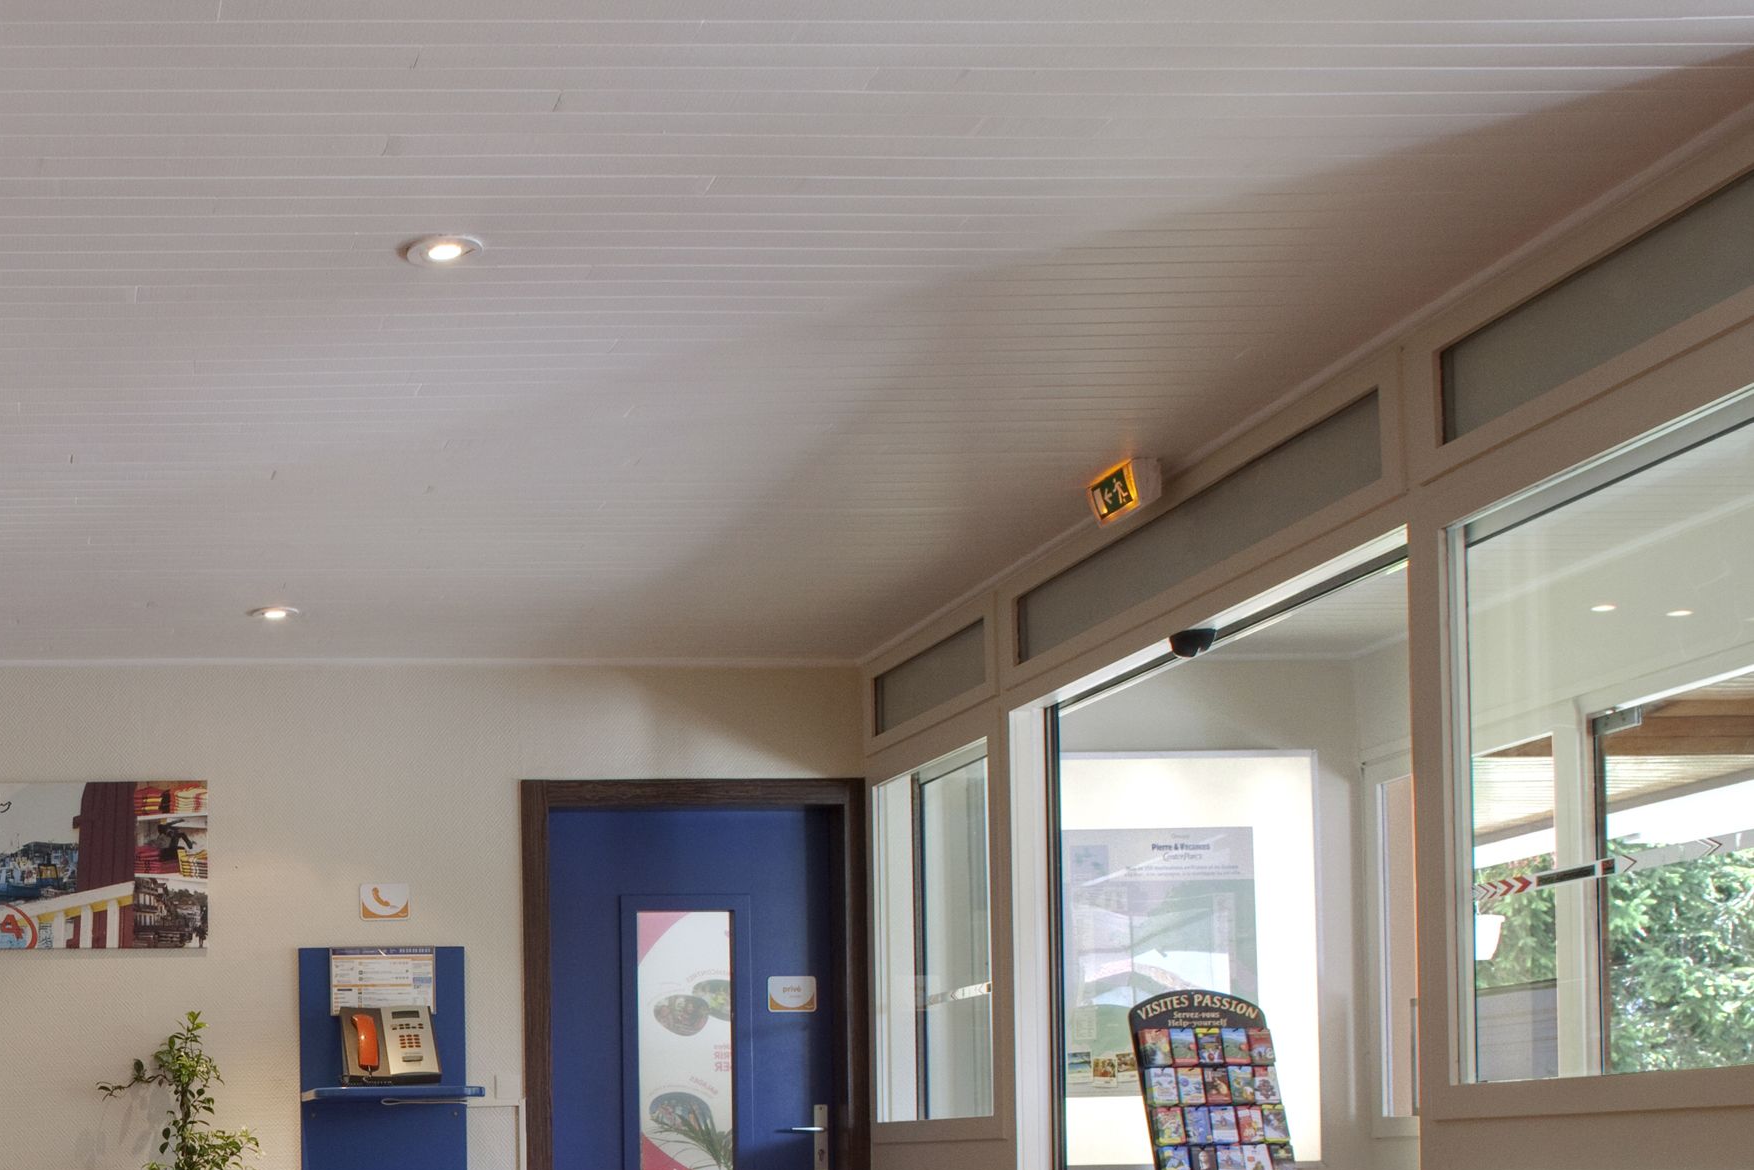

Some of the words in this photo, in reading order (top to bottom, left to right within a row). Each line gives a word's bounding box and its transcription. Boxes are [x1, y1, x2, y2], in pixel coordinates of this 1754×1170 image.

[1152, 843, 1172, 851] Pierre
[1137, 994, 1189, 1020] VISITES
[1194, 994, 1259, 1020] PASSION
[1173, 1010, 1220, 1020] Servez-vous
[1168, 1018, 1229, 1028] Help-yourself
